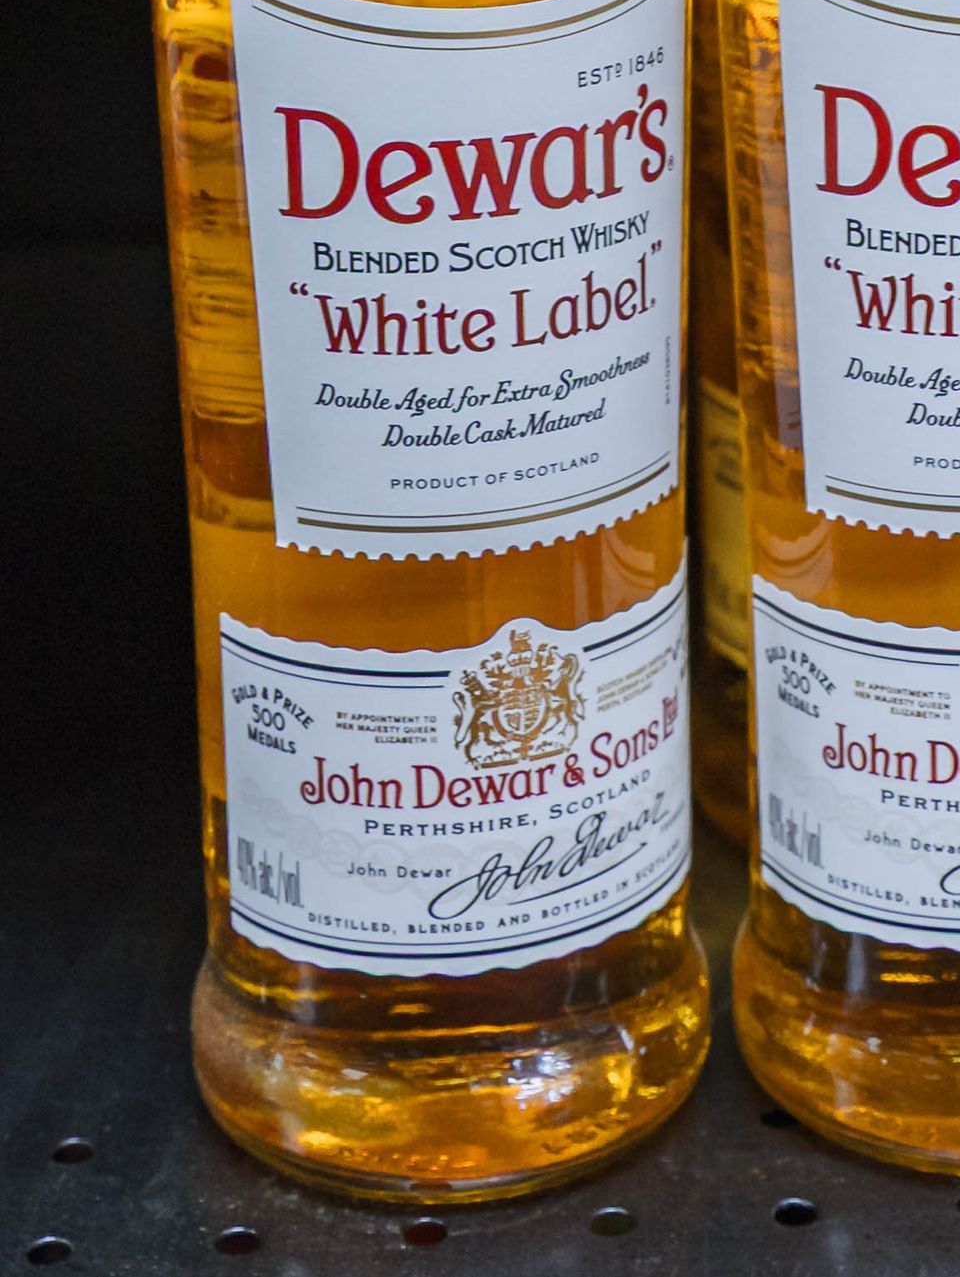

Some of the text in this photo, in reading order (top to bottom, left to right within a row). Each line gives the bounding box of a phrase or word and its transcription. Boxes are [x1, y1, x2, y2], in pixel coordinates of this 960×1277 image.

[629, 46, 665, 76] 1846
[274, 83, 668, 224] Dewar's
[314, 211, 650, 274] BLENDED SCOTCH WHISKY
[315, 351, 650, 417] Double Aged for Extra Smoothness
[844, 357, 916, 388] Double
[381, 398, 607, 448] Double Cask Matured
[390, 451, 601, 490] PRODUCT OF SCOTLAND
[801, 652, 837, 696] PRIZE
[231, 684, 257, 705] GOLD
[274, 689, 315, 729] PRIZE
[252, 704, 286, 732] 500
[248, 724, 297, 755] MEDALS
[823, 723, 917, 782] John
[301, 756, 402, 809] John
[412, 763, 556, 808] Dewar
[563, 754, 585, 788] &
[591, 720, 659, 777] Sons
[364, 814, 538, 836] PERTHSHIRE,
[550, 768, 651, 819] SCOTLAND
[864, 829, 901, 847] John
[347, 862, 452, 879] John Dewar
[828, 874, 910, 905] DISTILLED,
[308, 912, 397, 935] DISTILLED,
[408, 920, 485, 934] BLENDED
[498, 913, 530, 928] AND
[542, 889, 609, 919] BOTTLED
